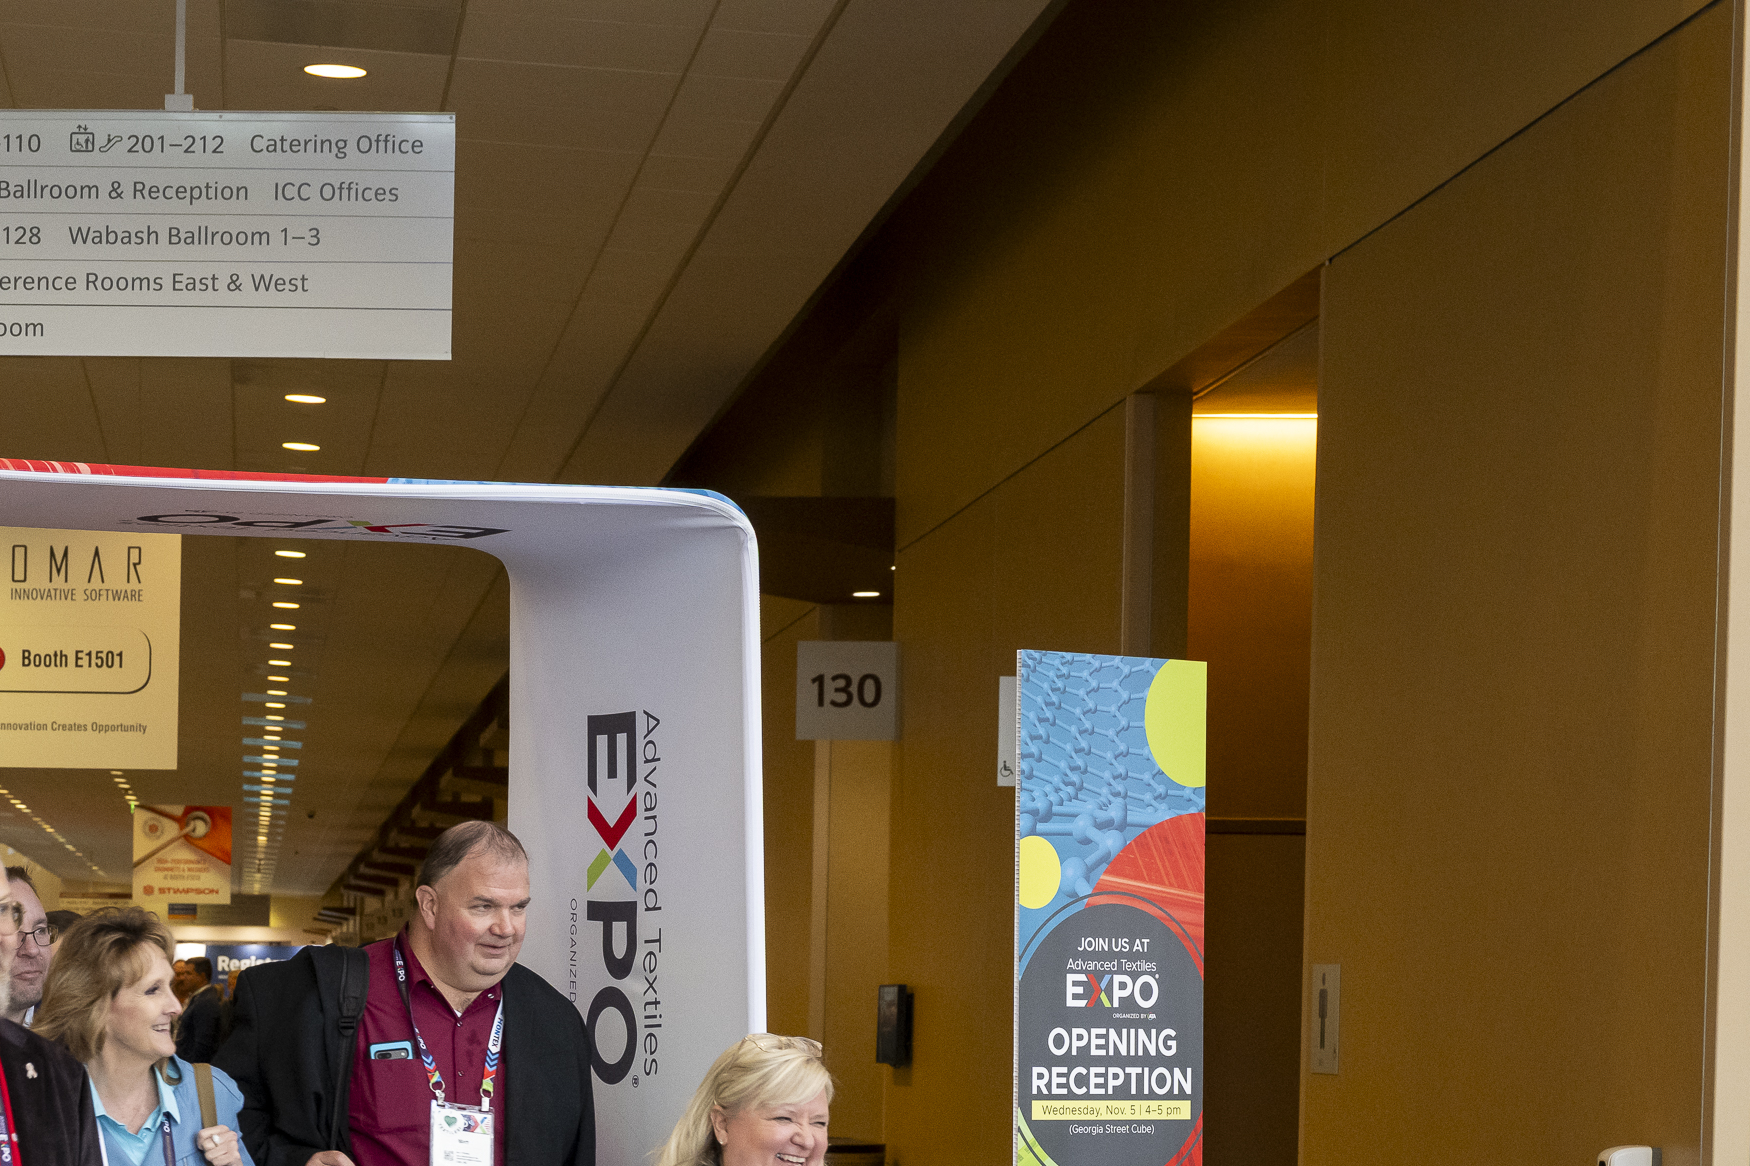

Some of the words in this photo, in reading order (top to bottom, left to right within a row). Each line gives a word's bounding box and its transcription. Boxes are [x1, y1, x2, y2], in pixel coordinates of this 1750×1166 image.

[126, 134, 225, 155] 201–212
[250, 133, 348, 159] Catering
[356, 133, 424, 155] Office
[108, 181, 124, 200] &
[133, 180, 248, 206] Reception
[274, 182, 312, 201] ICC
[320, 181, 399, 202] Offices
[69, 225, 159, 246] Wabash
[168, 225, 270, 247] Ballroom
[280, 226, 321, 247] 1–3
[86, 272, 164, 292] Rooms
[172, 273, 219, 293] East
[227, 273, 243, 293] &
[251, 273, 309, 293] West
[10, 588, 76, 601] INNOVATIVE
[83, 589, 143, 602] SOFTWARE
[21, 649, 68, 668] Booth
[75, 650, 125, 668] E1501
[811, 673, 882, 708] 130
[51, 721, 88, 732] Creates
[91, 722, 147, 735] Opportunity
[642, 709, 662, 911] Advanced
[158, 887, 219, 895] STIMPSON
[569, 898, 578, 1003] ORGANIZED
[1078, 937, 1108, 951] JOIN
[1112, 938, 1129, 951] US
[1133, 938, 1150, 952] AT
[395, 960, 406, 982] EXPO
[1067, 958, 1117, 971] Advanced
[1120, 960, 1157, 972] Textiles
[643, 928, 662, 1076] Textiles
[1048, 1027, 1177, 1057] OPENING
[1031, 1066, 1192, 1095] RECEPTION
[1042, 1104, 1102, 1117] Wednesday,
[1105, 1105, 1127, 1117] Nov.
[1130, 1105, 1136, 1116] 5
[1166, 1107, 1181, 1118] pm
[1069, 1124, 1103, 1136] (Georgia
[1105, 1124, 1130, 1135] Street
[1131, 1124, 1155, 1135] Cube)
